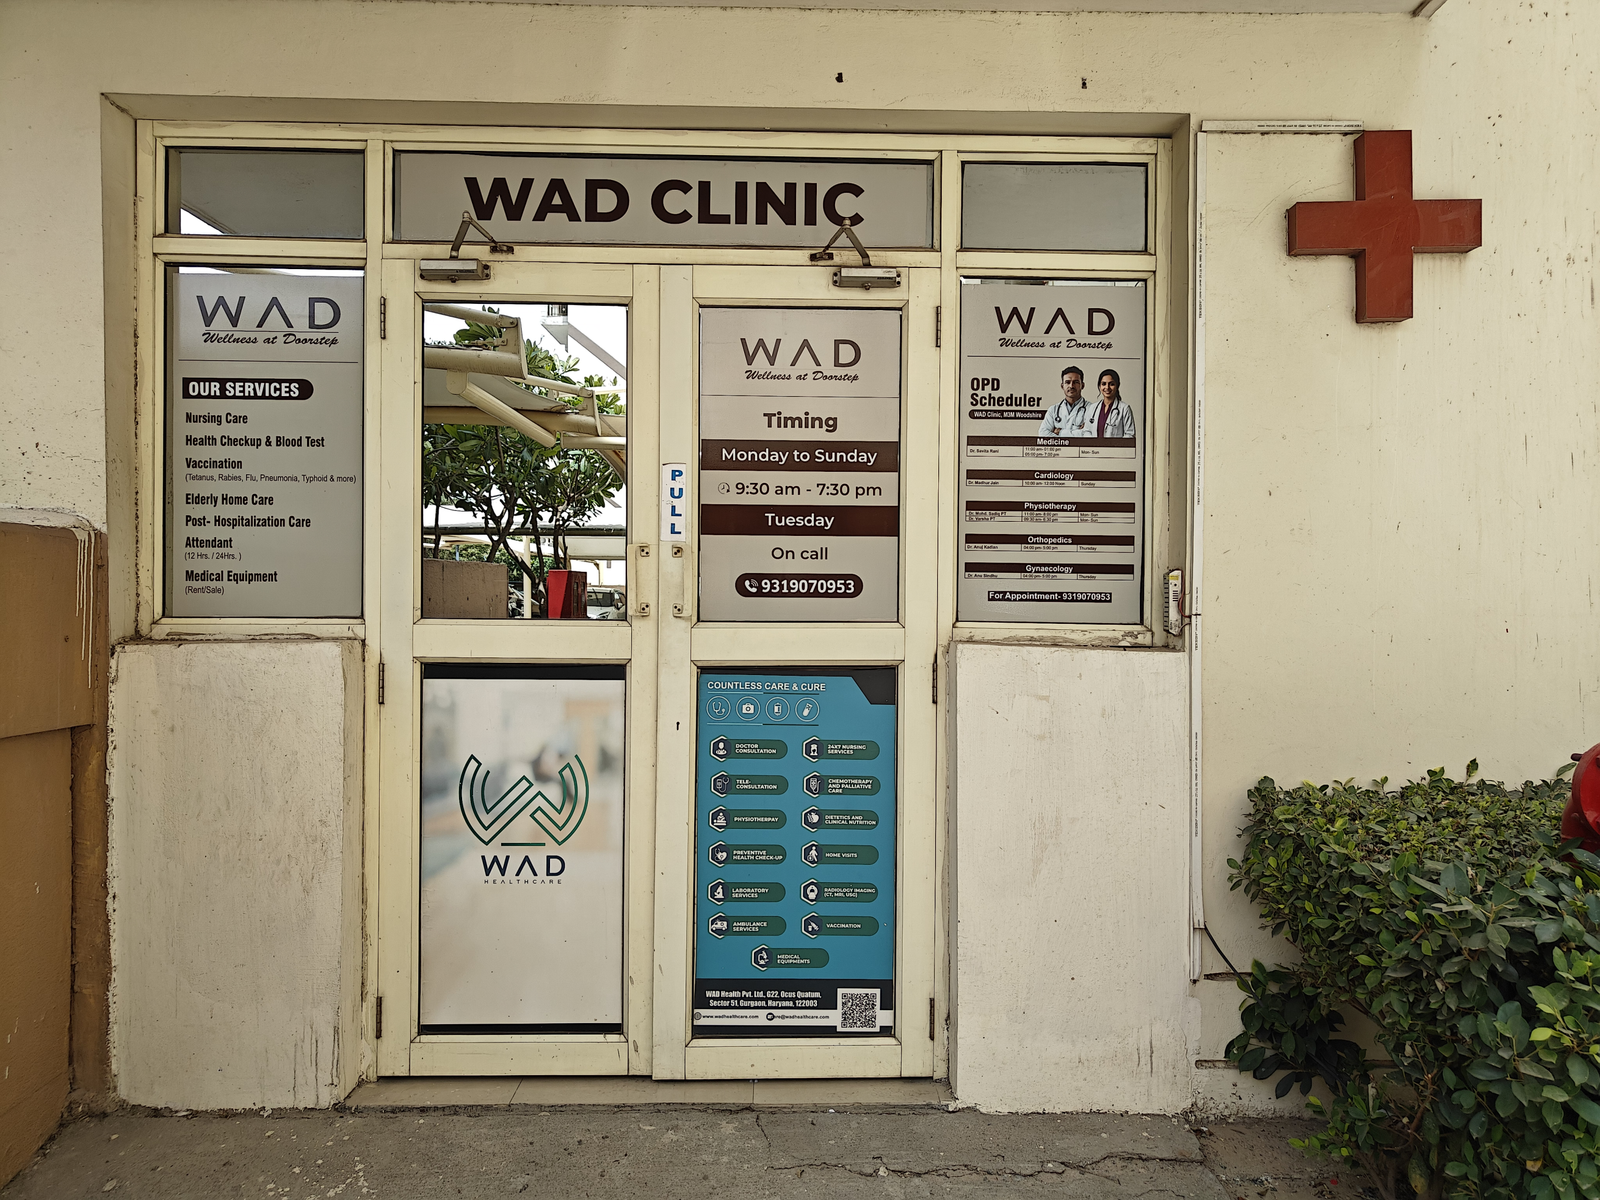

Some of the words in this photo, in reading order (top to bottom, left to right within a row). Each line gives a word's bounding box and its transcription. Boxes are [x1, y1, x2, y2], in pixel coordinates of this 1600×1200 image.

[464, 177, 630, 223] WAD
[651, 179, 865, 227] CLINIC
[196, 295, 341, 329] WAD
[994, 306, 1115, 335] WAD
[201, 332, 258, 344] Wellness
[263, 335, 277, 344] at
[283, 333, 338, 347] Doorstep
[998, 338, 1046, 348] Wellness
[1065, 339, 1113, 351] Doorstep
[740, 338, 862, 367] WAD
[745, 370, 792, 381] Wellness
[796, 372, 808, 381] at
[812, 371, 859, 383] Doorstep
[189, 381, 220, 396] OUR
[226, 382, 299, 397] SERVICES
[971, 377, 1000, 391] OPD
[970, 393, 1042, 407] Scheduler
[186, 412, 222, 425] Nursing
[226, 412, 248, 423] Care
[763, 411, 838, 433] Timing
[185, 435, 217, 447] Health
[220, 435, 262, 449] Checkup
[265, 436, 272, 447] &
[275, 436, 302, 447] Blood
[305, 436, 325, 447] Test
[185, 457, 243, 469] Vaccination
[722, 447, 789, 465] Monday
[793, 449, 810, 462] to
[814, 449, 878, 465] Sunday
[185, 474, 216, 482] (Tetanus,
[218, 474, 244, 482] Rabies,
[246, 474, 259, 482] Flu,
[302, 475, 328, 483] Typhoid
[336, 475, 357, 483] more)
[1034, 472, 1074, 480] Cardiology
[735, 482, 769, 495] 9:30
[774, 484, 801, 496] am
[816, 483, 850, 496] 7:30
[855, 485, 882, 499] pm
[185, 493, 218, 507] Elderly
[221, 494, 248, 505] Home
[251, 494, 274, 505] Care
[670, 469, 683, 535] PULL
[185, 515, 211, 527] Post-
[214, 516, 286, 529] Hospitalization
[288, 516, 311, 527] Care
[765, 513, 835, 530] Tuesday
[185, 537, 233, 548] Attendant
[1028, 536, 1072, 544] Orthopedics
[771, 547, 795, 560] On
[800, 547, 828, 560] call
[185, 570, 224, 582] Medical
[227, 570, 278, 584] Equipment
[185, 586, 224, 594] (Rent/Sale)
[761, 579, 855, 593] 9319070953
[1005, 592, 1061, 601] Appointment-
[1062, 592, 1111, 600] 9319070953
[707, 681, 762, 690] COUNTLESS
[764, 682, 790, 690] CARE
[792, 683, 799, 691] &
[801, 683, 826, 691] CURE
[481, 855, 566, 877] WAD
[768, 1000, 794, 1008] Haryana,
